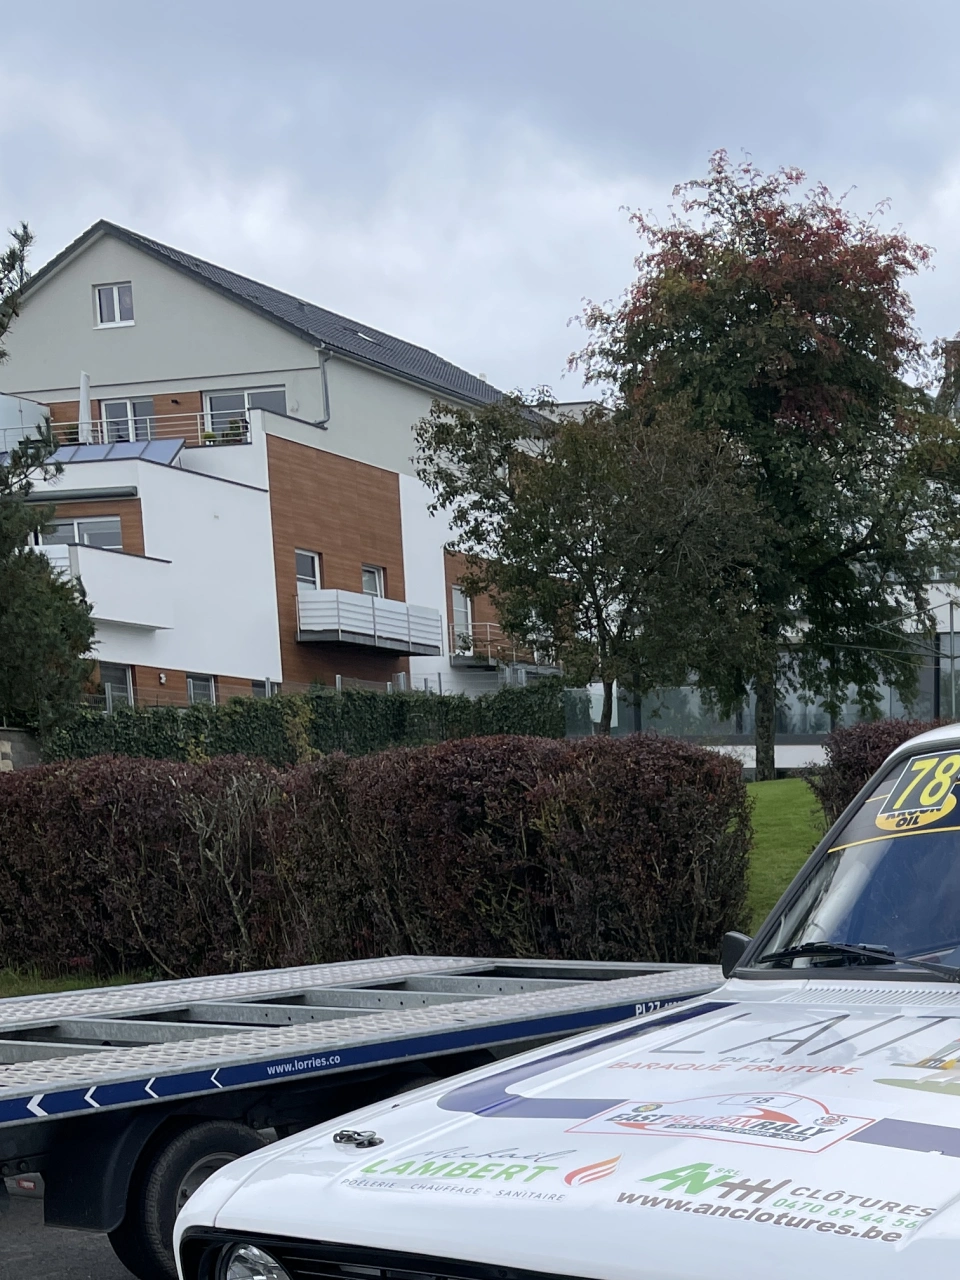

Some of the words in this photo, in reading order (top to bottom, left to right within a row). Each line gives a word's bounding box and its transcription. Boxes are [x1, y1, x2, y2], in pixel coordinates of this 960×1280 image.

[267, 1054, 341, 1075] www.lorries.co
[607, 1061, 732, 1072] BARAQUE
[735, 1063, 864, 1075] FRAITURE
[360, 1158, 560, 1183] LAMBERT
[410, 1183, 482, 1196] CHAUFFAGE
[495, 1189, 566, 1202] SANITAIRE
[790, 1185, 938, 1218] CLÔTURES
[615, 1191, 903, 1243] www.anclotures.be
[772, 1198, 824, 1214] 0470
[827, 1205, 856, 1219] 69
[858, 1211, 886, 1225] 44
[891, 1217, 920, 1229] 56
